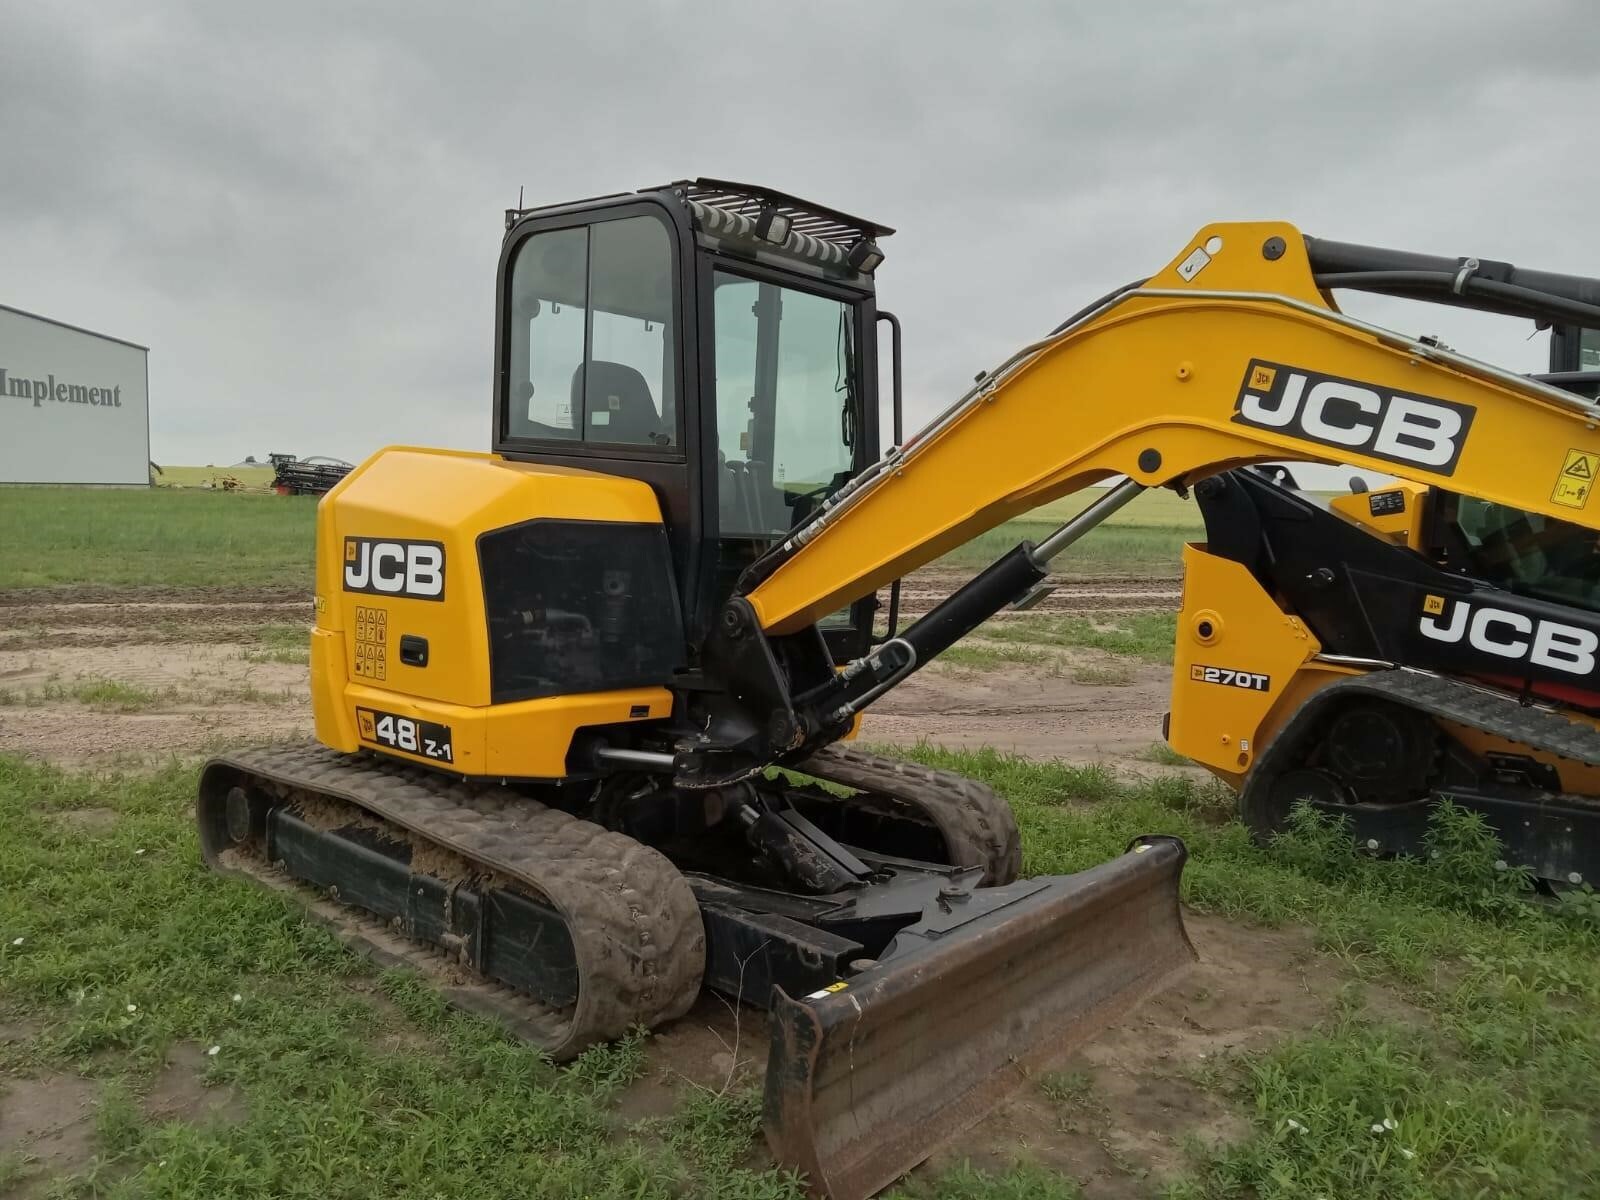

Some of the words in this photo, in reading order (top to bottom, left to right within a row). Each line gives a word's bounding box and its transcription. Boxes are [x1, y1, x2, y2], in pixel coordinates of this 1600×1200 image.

[0, 368, 122, 408] Implement
[1241, 373, 1462, 466] JCB
[345, 542, 443, 596] JCB
[1419, 601, 1599, 675] JCB
[1205, 667, 1268, 690] 270T
[377, 715, 417, 751] 48
